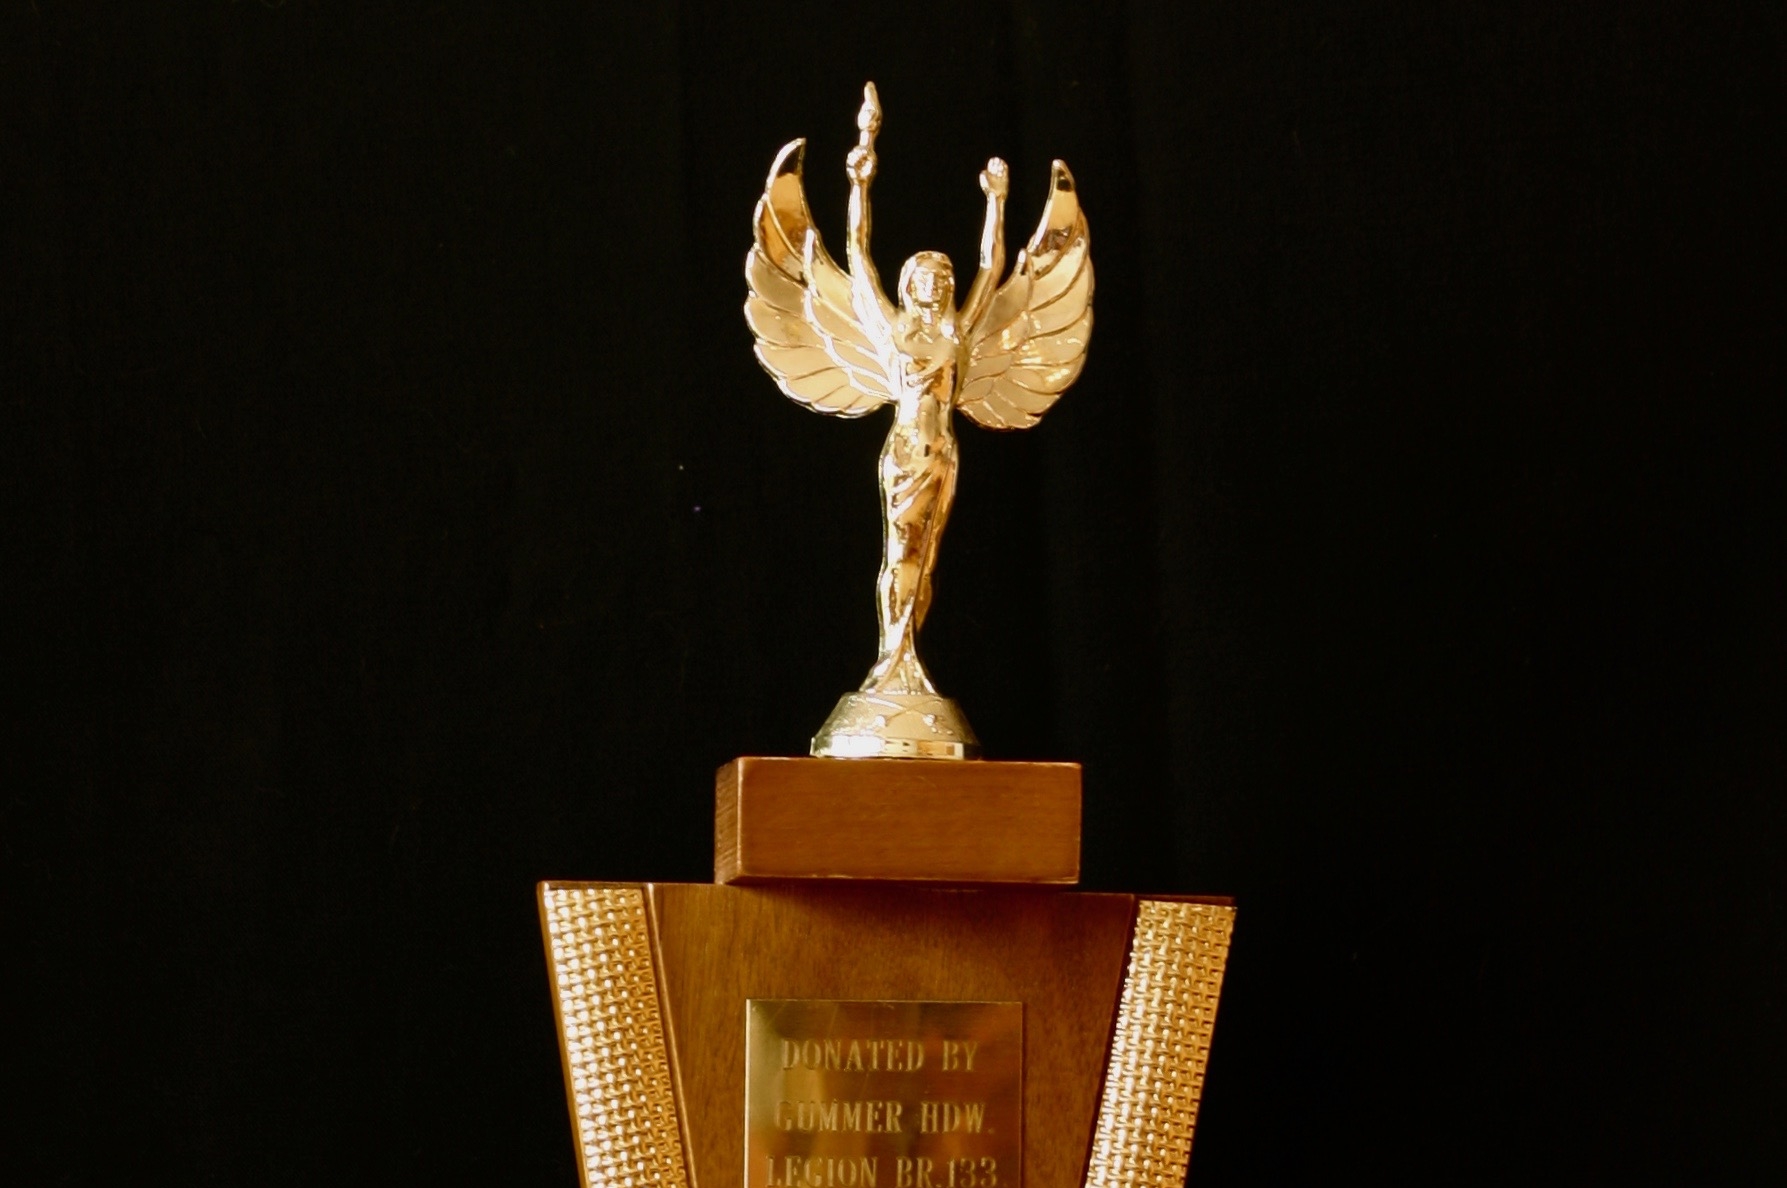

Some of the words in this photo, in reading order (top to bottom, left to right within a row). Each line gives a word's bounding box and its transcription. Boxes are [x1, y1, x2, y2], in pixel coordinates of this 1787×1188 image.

[781, 1038, 925, 1072] DONATED
[941, 1039, 979, 1072] BY
[773, 1100, 903, 1133] GUMMER
[765, 1154, 878, 1188] LEGION
